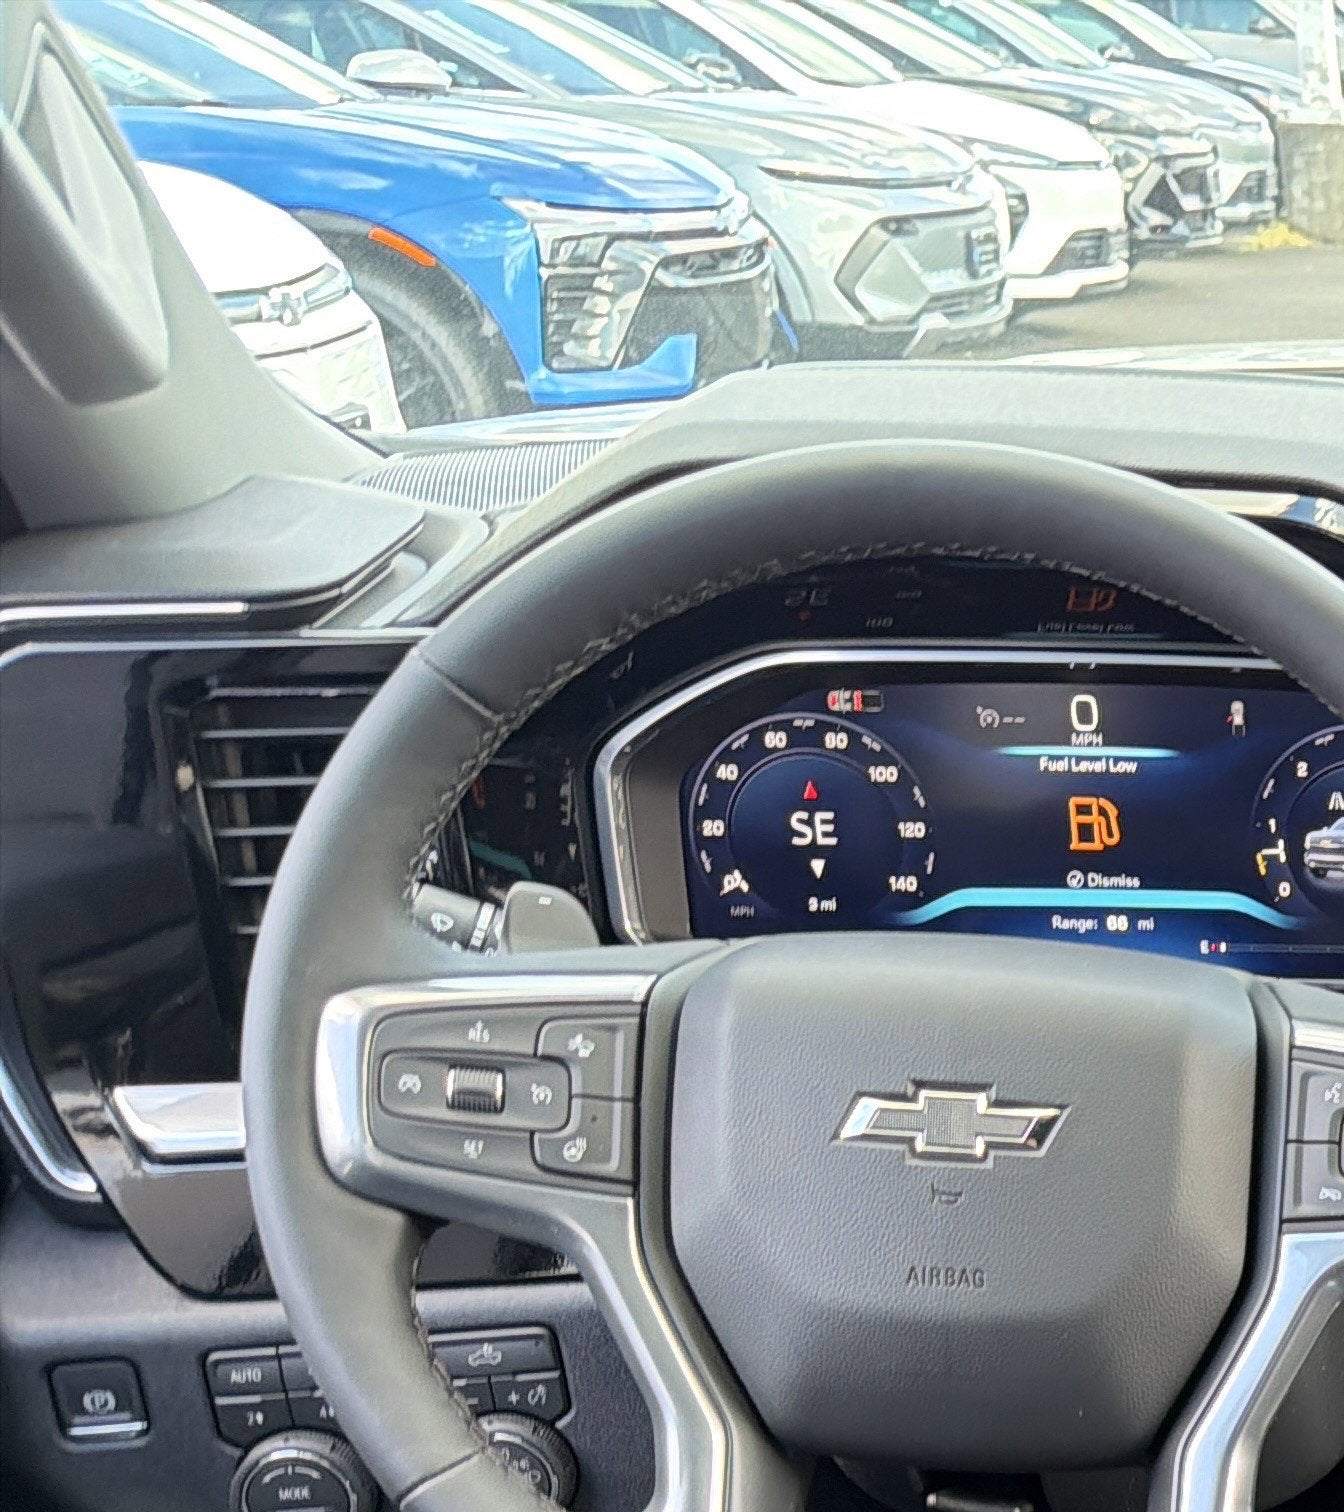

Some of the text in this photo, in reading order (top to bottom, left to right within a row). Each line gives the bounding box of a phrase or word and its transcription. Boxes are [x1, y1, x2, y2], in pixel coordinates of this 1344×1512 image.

[1070, 694, 1099, 732] 0
[1071, 732, 1103, 747] MPH
[716, 763, 738, 781] 40
[1039, 756, 1138, 774] Fuel Level Low
[1297, 761, 1308, 778] 2
[868, 765, 899, 783] 100
[702, 819, 725, 837] 20
[790, 810, 838, 846] SE
[898, 821, 925, 839] 120
[1268, 818, 1277, 834] 1
[889, 875, 918, 892] 140
[1087, 872, 1141, 888] Dismiss
[1278, 882, 1291, 897] 0
[730, 905, 755, 918] MPH
[1051, 914, 1098, 933] Range:
[1137, 915, 1155, 931] mi
[905, 1265, 986, 1288] AIRBAG
[230, 1367, 262, 1384] AUTO
[278, 1485, 311, 1501] MODE
